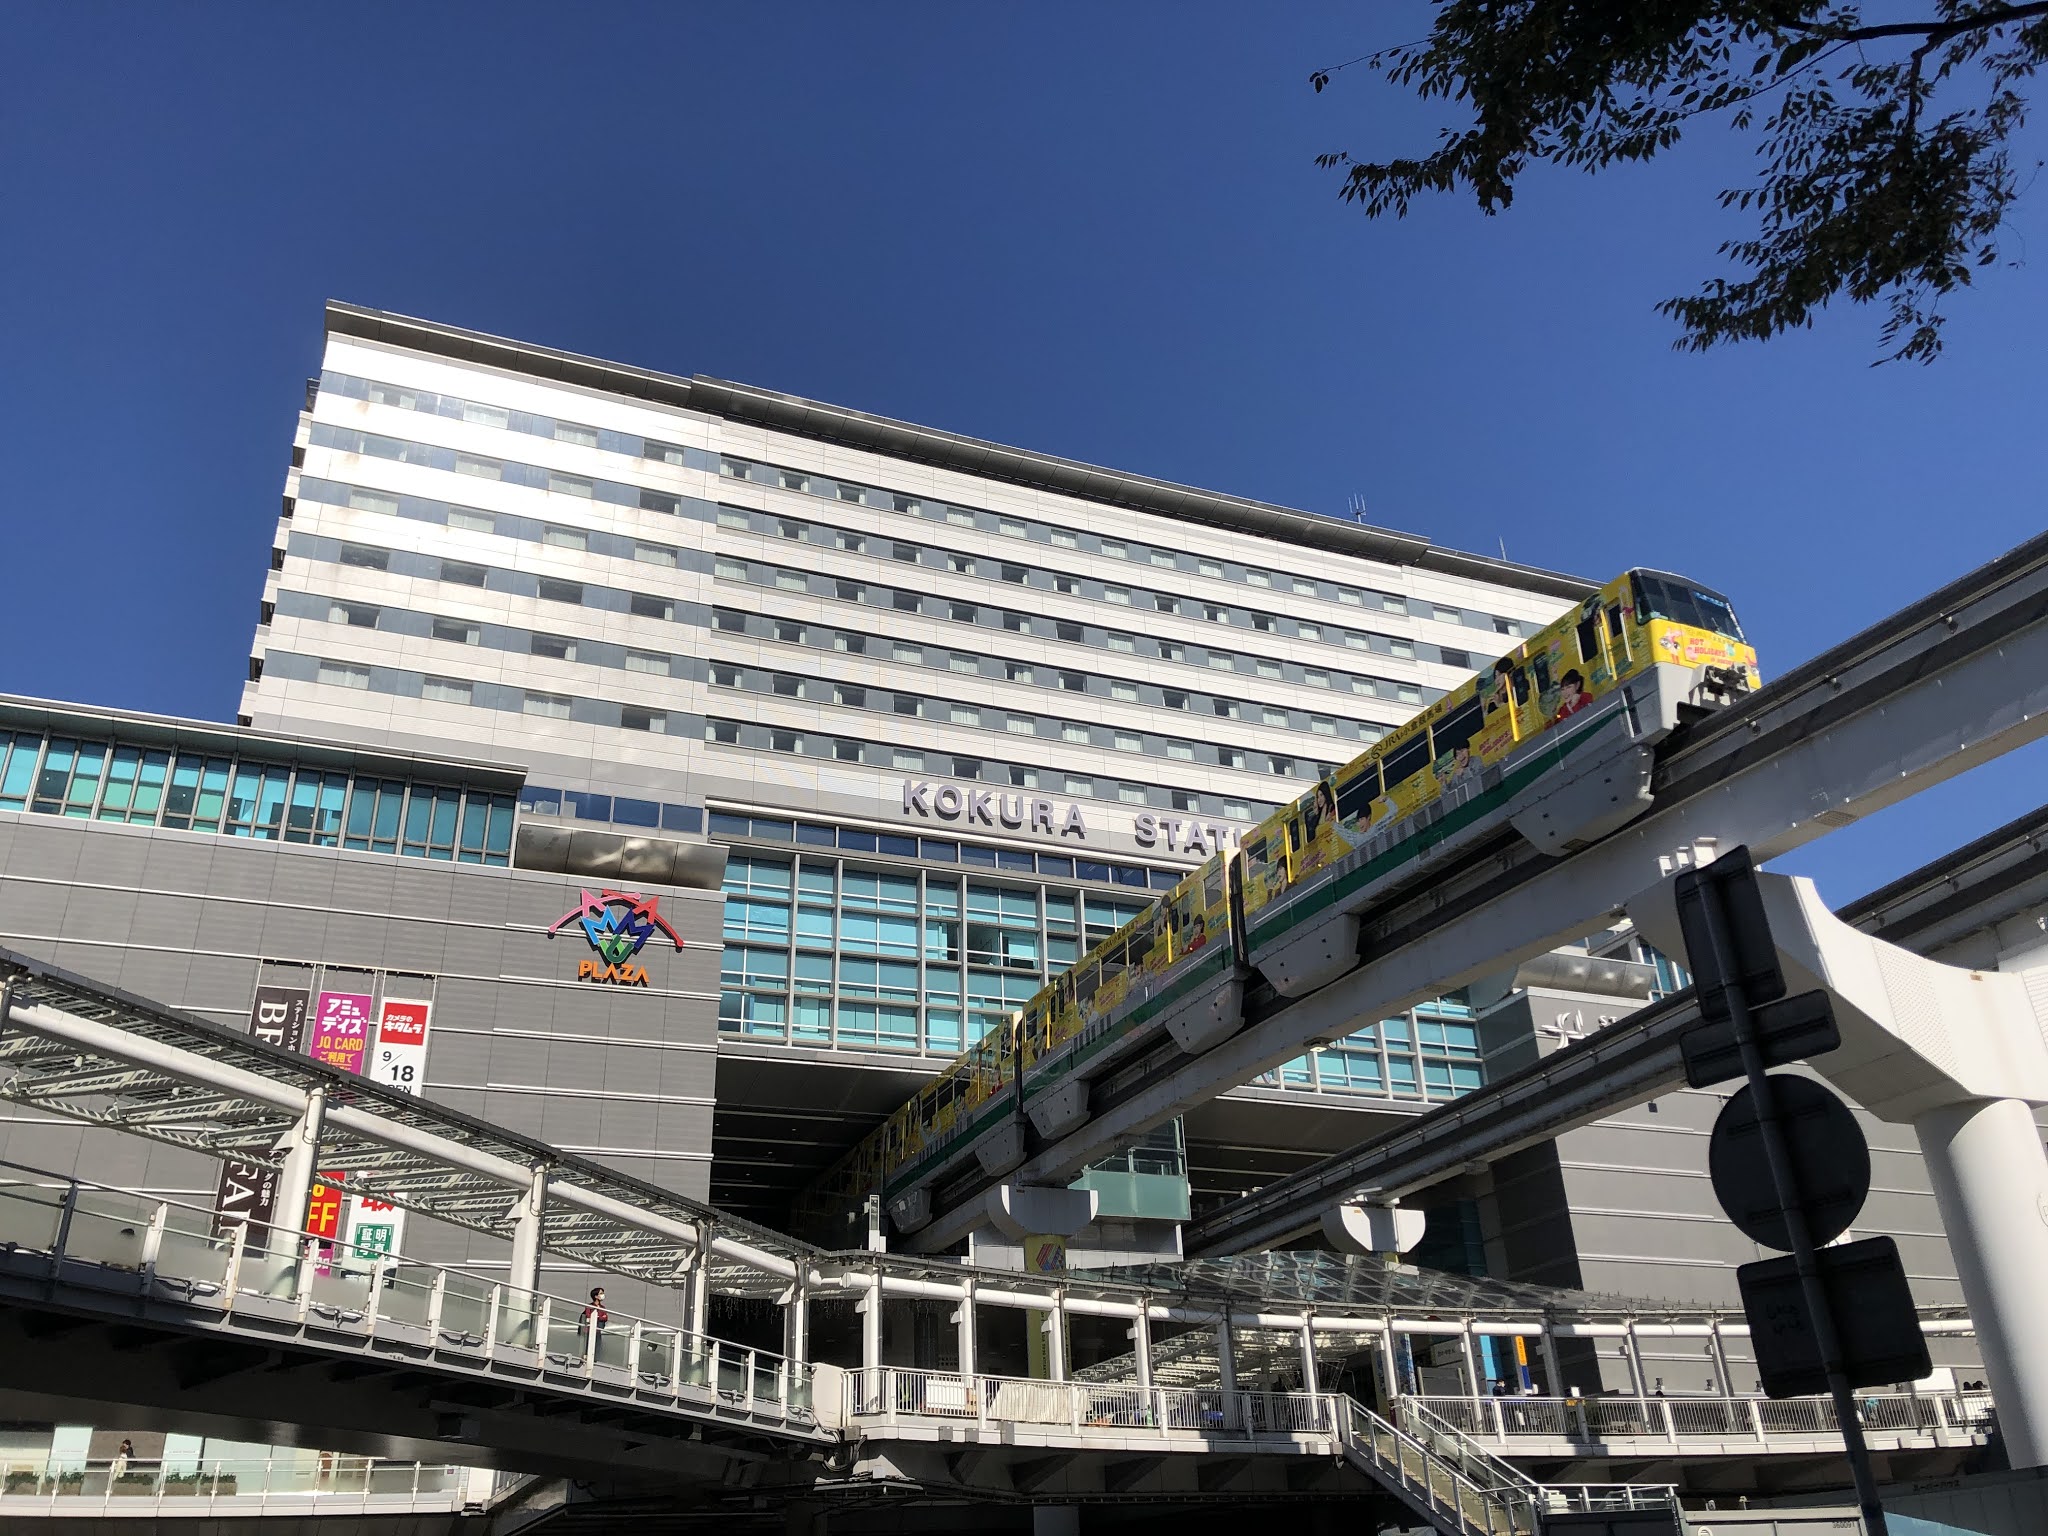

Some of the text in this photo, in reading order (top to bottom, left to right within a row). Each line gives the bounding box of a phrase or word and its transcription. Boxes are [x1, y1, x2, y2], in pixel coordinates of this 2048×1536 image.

[903, 779, 1088, 834] KOKURA
[578, 959, 650, 983] PLAZA
[327, 998, 361, 1015] アミュ
[322, 1015, 367, 1034] デイズ
[383, 1021, 423, 1034] キタムラ
[316, 1035, 364, 1051] JQ CARD
[306, 1202, 338, 1233] FF
[360, 1227, 388, 1242] 証明
